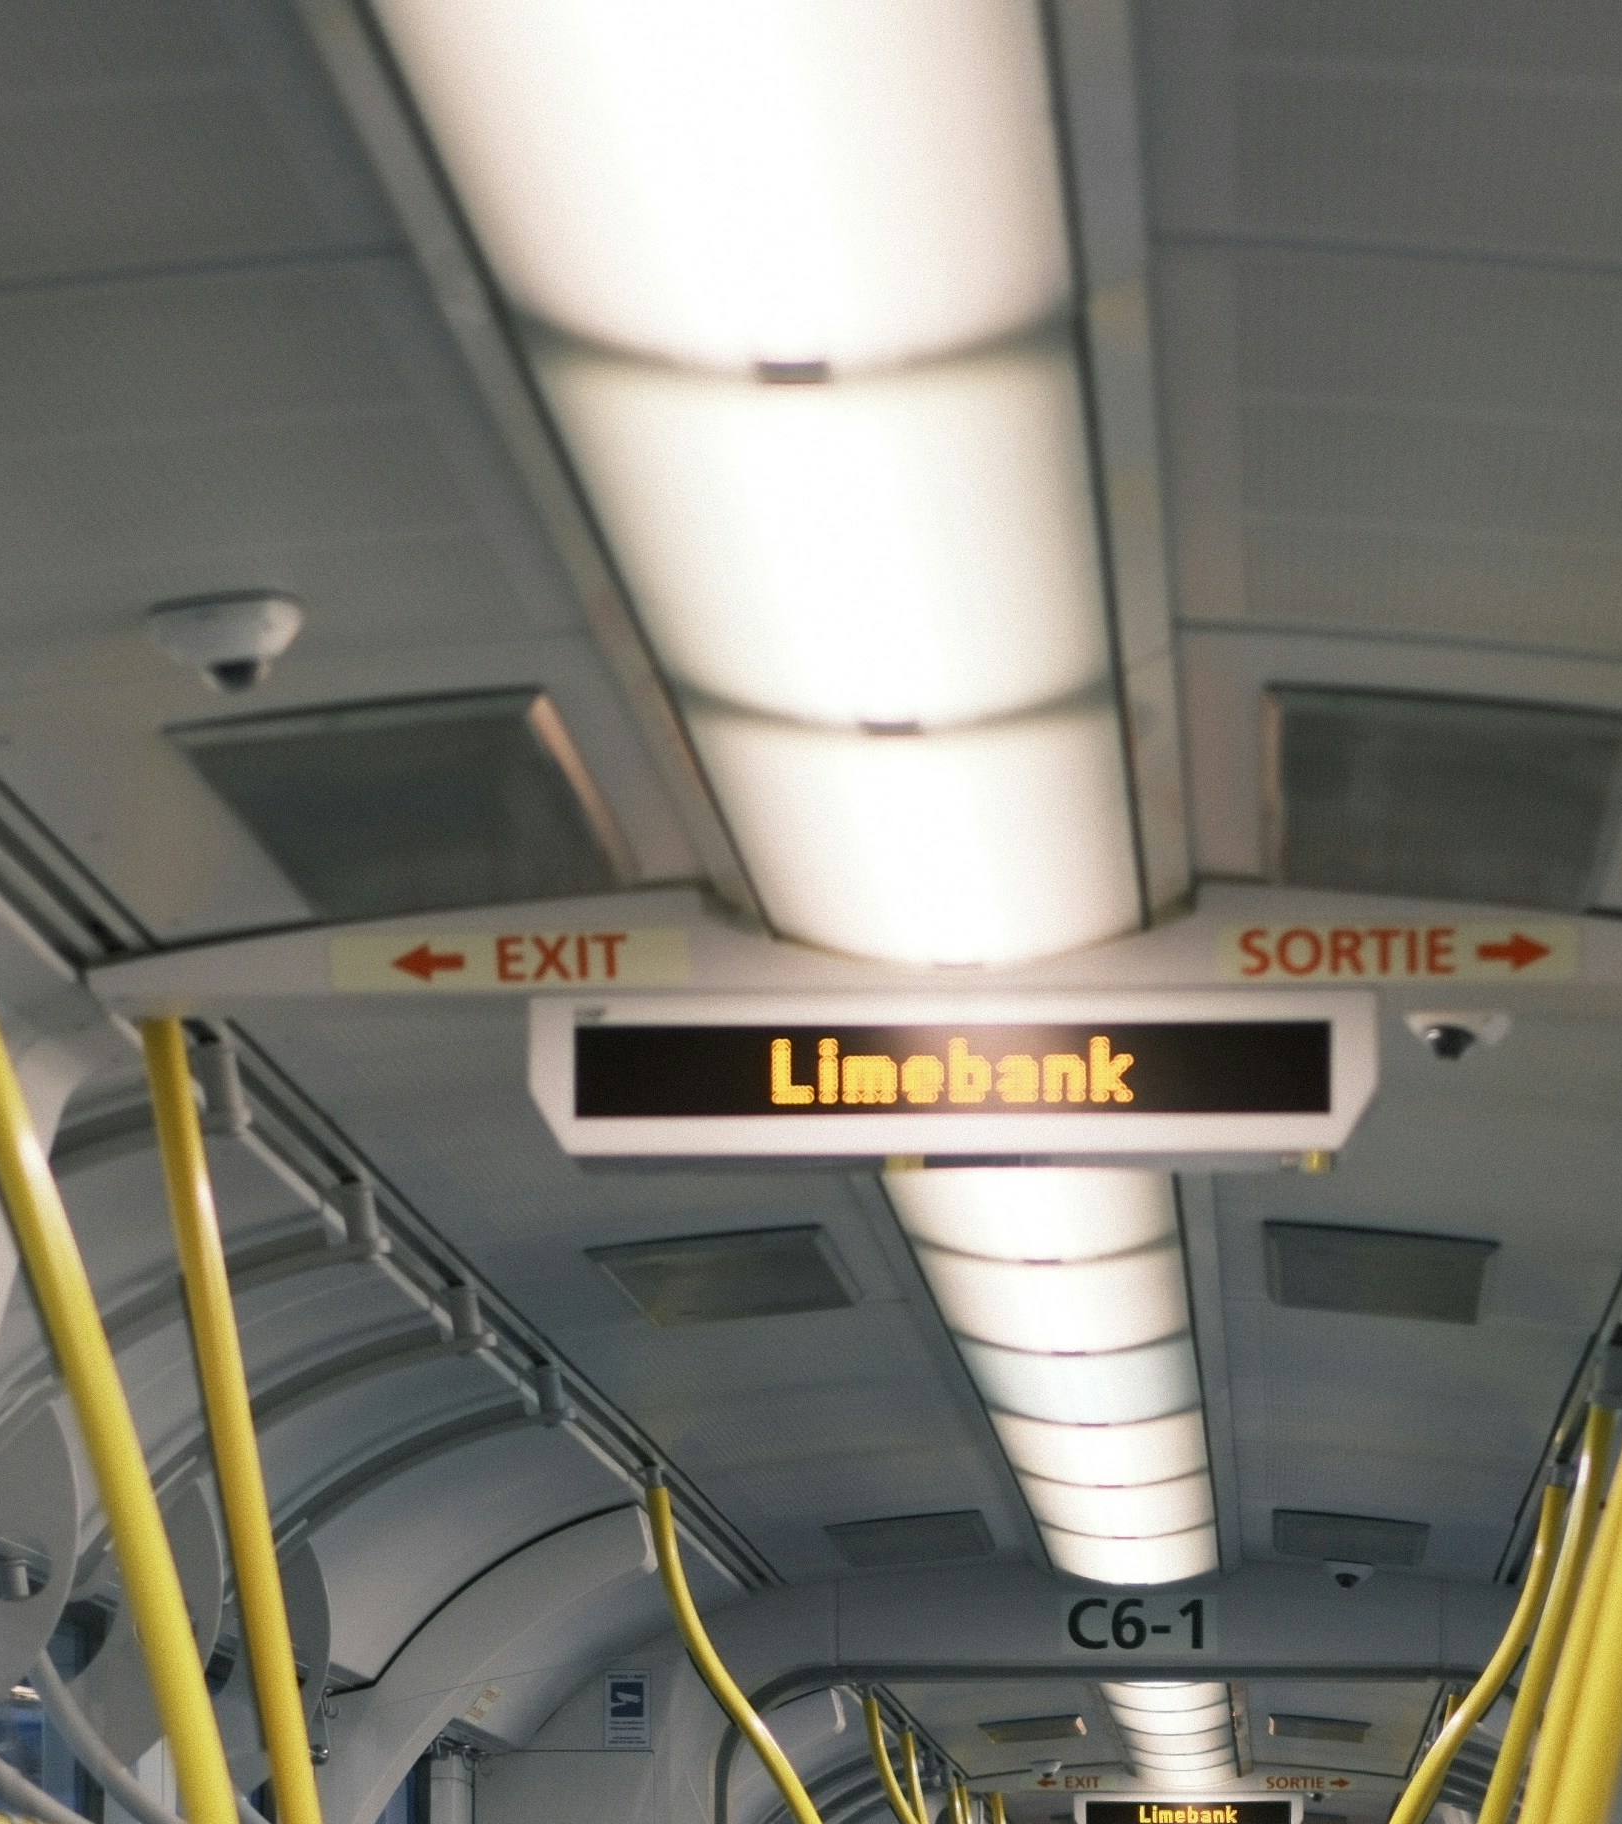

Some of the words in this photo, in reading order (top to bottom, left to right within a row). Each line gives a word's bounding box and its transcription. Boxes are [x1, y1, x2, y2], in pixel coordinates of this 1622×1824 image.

[495, 933, 627, 981] EXIT
[1239, 929, 1457, 976] SORTIE
[770, 1036, 1134, 1106] Limebank
[1067, 1598, 1204, 1650] C6-1
[1064, 1776, 1101, 1789] EXIT
[1266, 1776, 1325, 1789] SORTIE
[1139, 1804, 1238, 1824] Limebank
